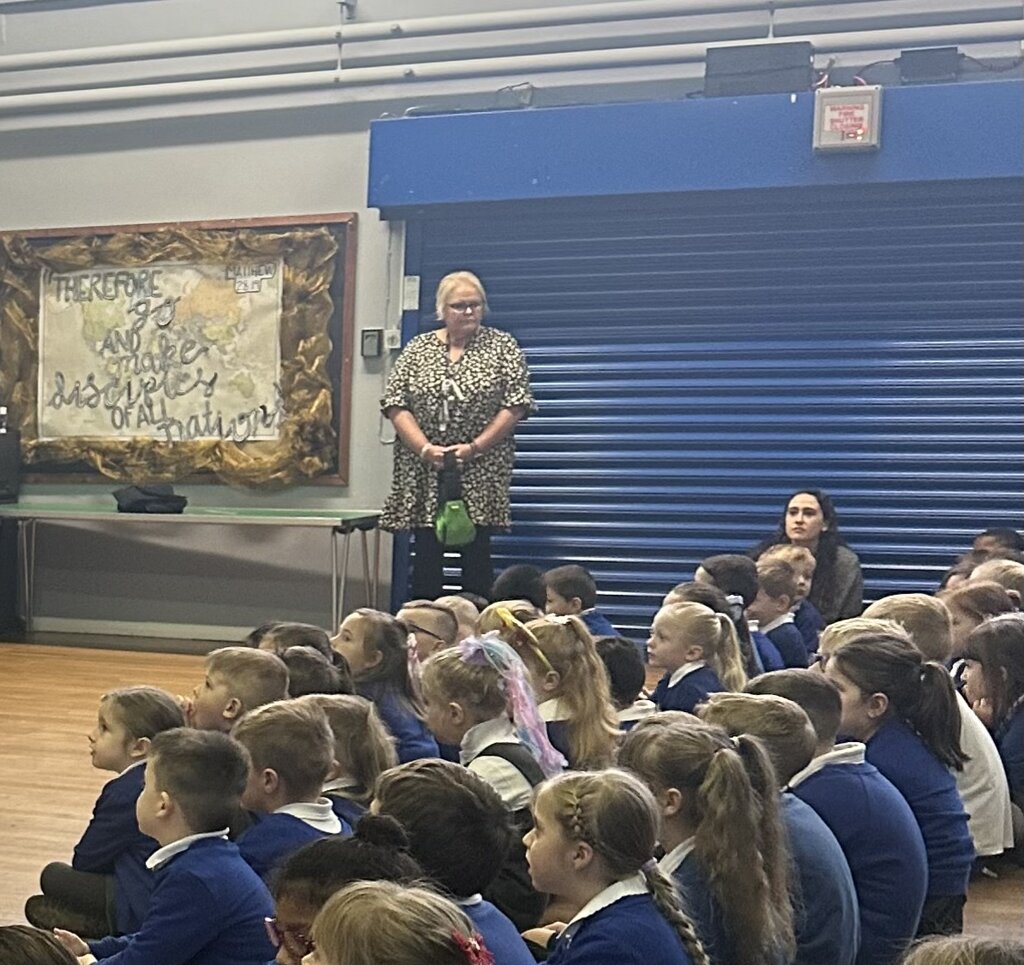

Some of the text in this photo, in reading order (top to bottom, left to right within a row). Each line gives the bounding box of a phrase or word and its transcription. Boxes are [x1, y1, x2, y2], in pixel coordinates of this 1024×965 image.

[101, 330, 140, 354] AND
[111, 333, 210, 376] make
[47, 371, 219, 409] disciples
[110, 399, 168, 430] OF ALL
